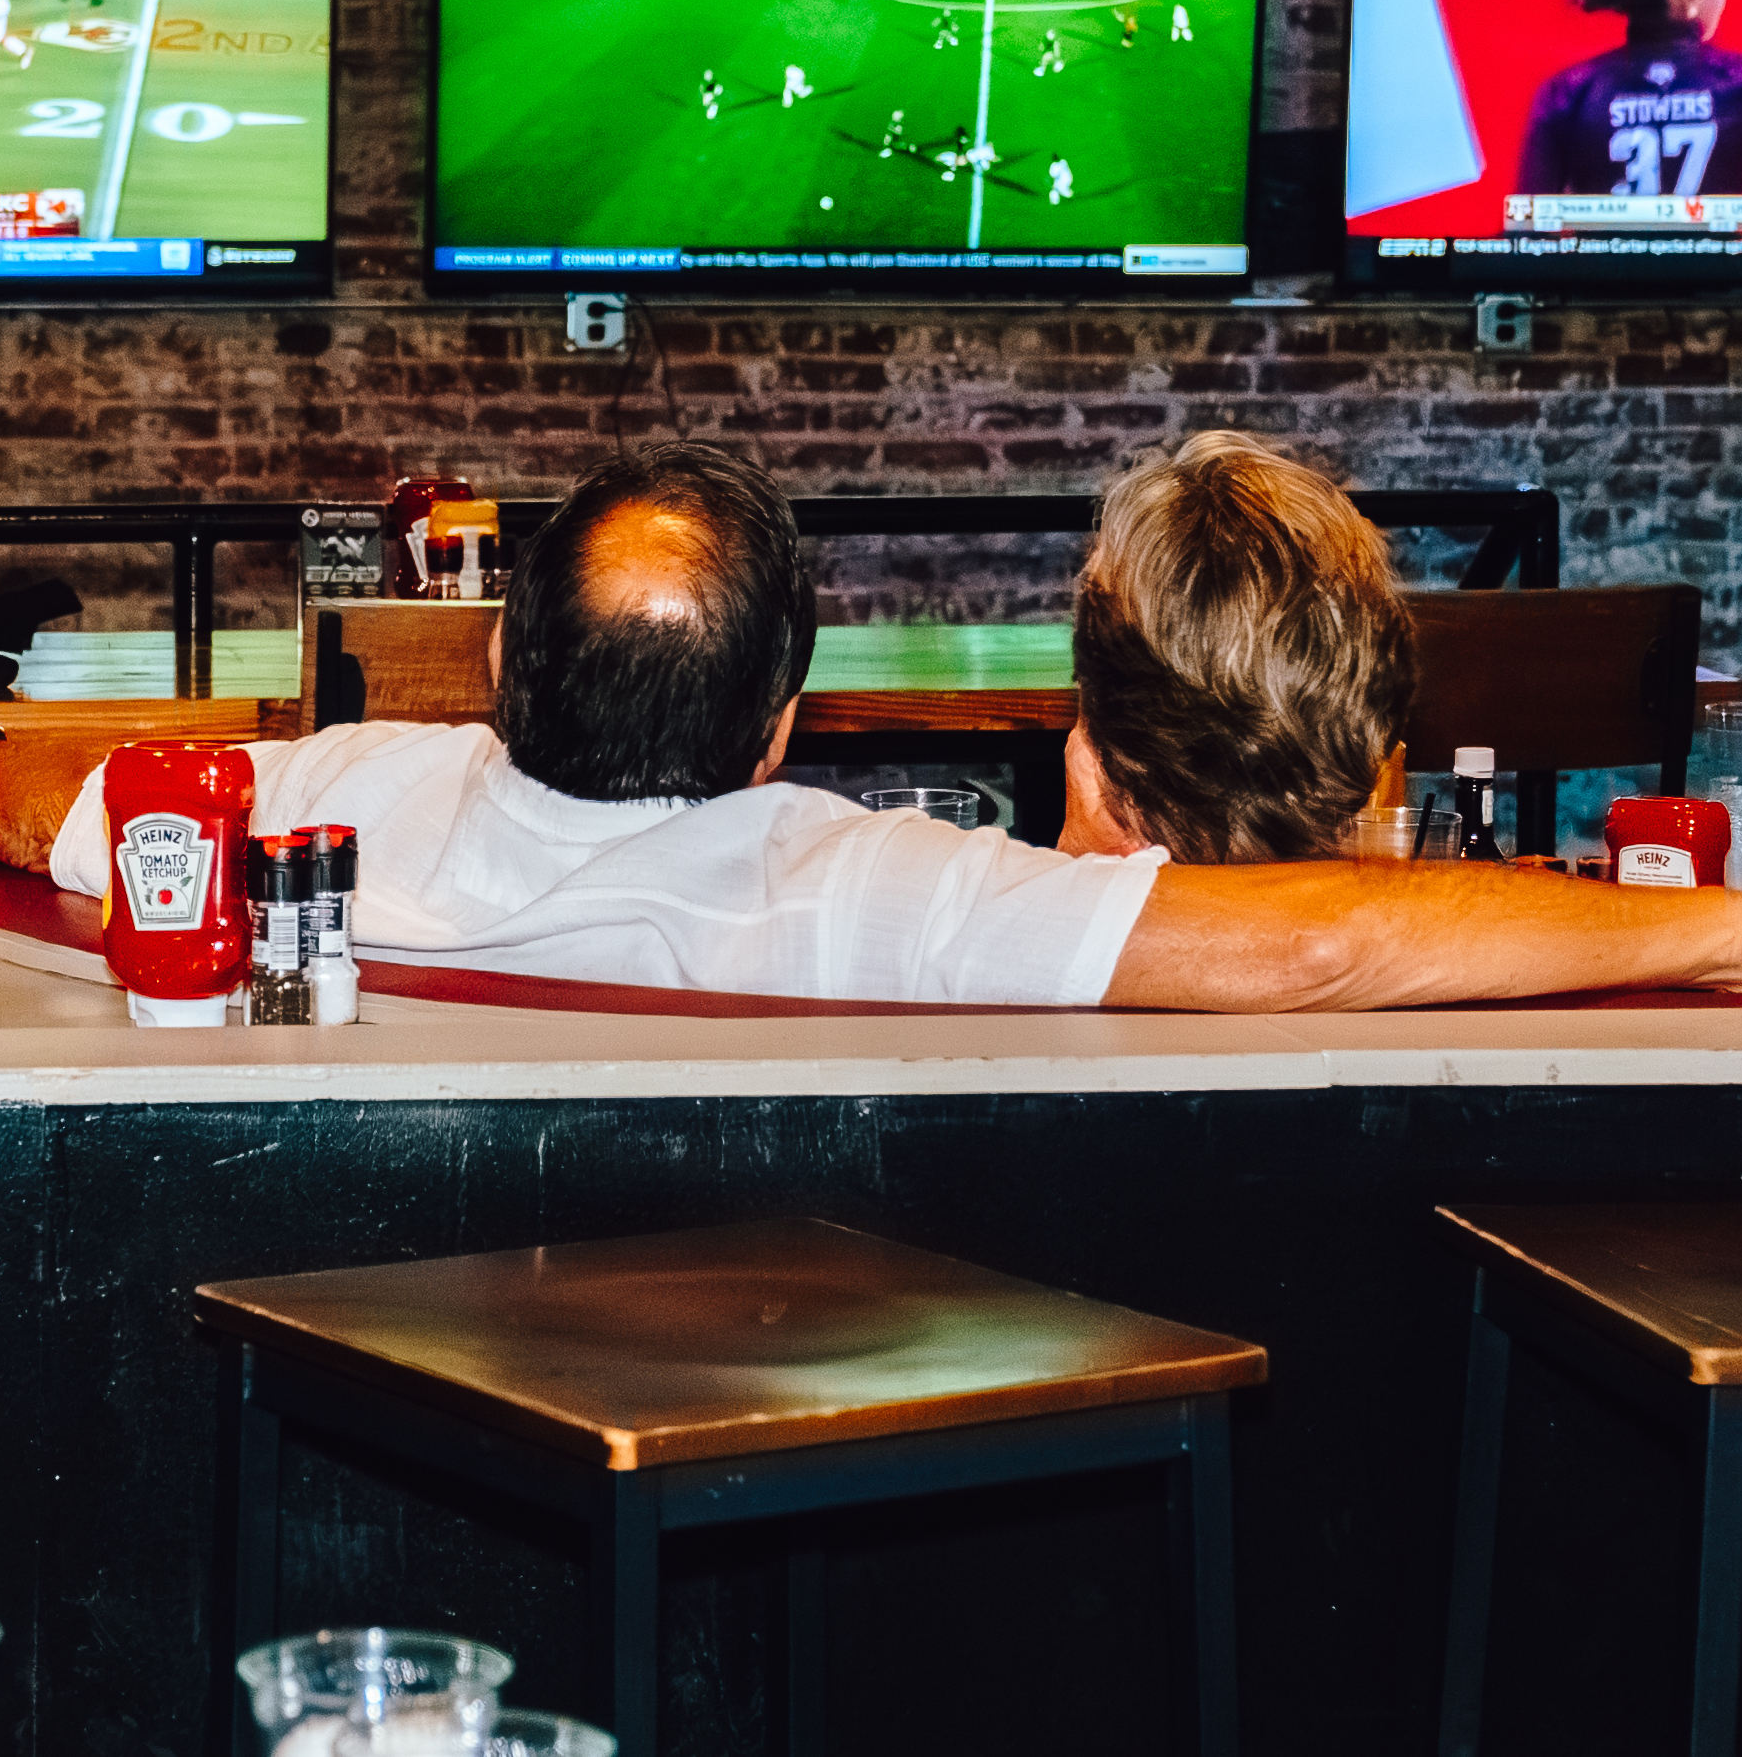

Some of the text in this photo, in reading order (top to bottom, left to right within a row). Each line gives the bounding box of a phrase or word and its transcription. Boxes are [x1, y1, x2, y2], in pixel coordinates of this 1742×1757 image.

[1609, 89, 1713, 127] STOWERS
[1609, 120, 1718, 197] 37
[139, 828, 183, 846] HEINZ
[138, 853, 189, 868] TOMATO
[1636, 851, 1671, 868] HEINZ
[142, 867, 187, 879] KETCHUP
